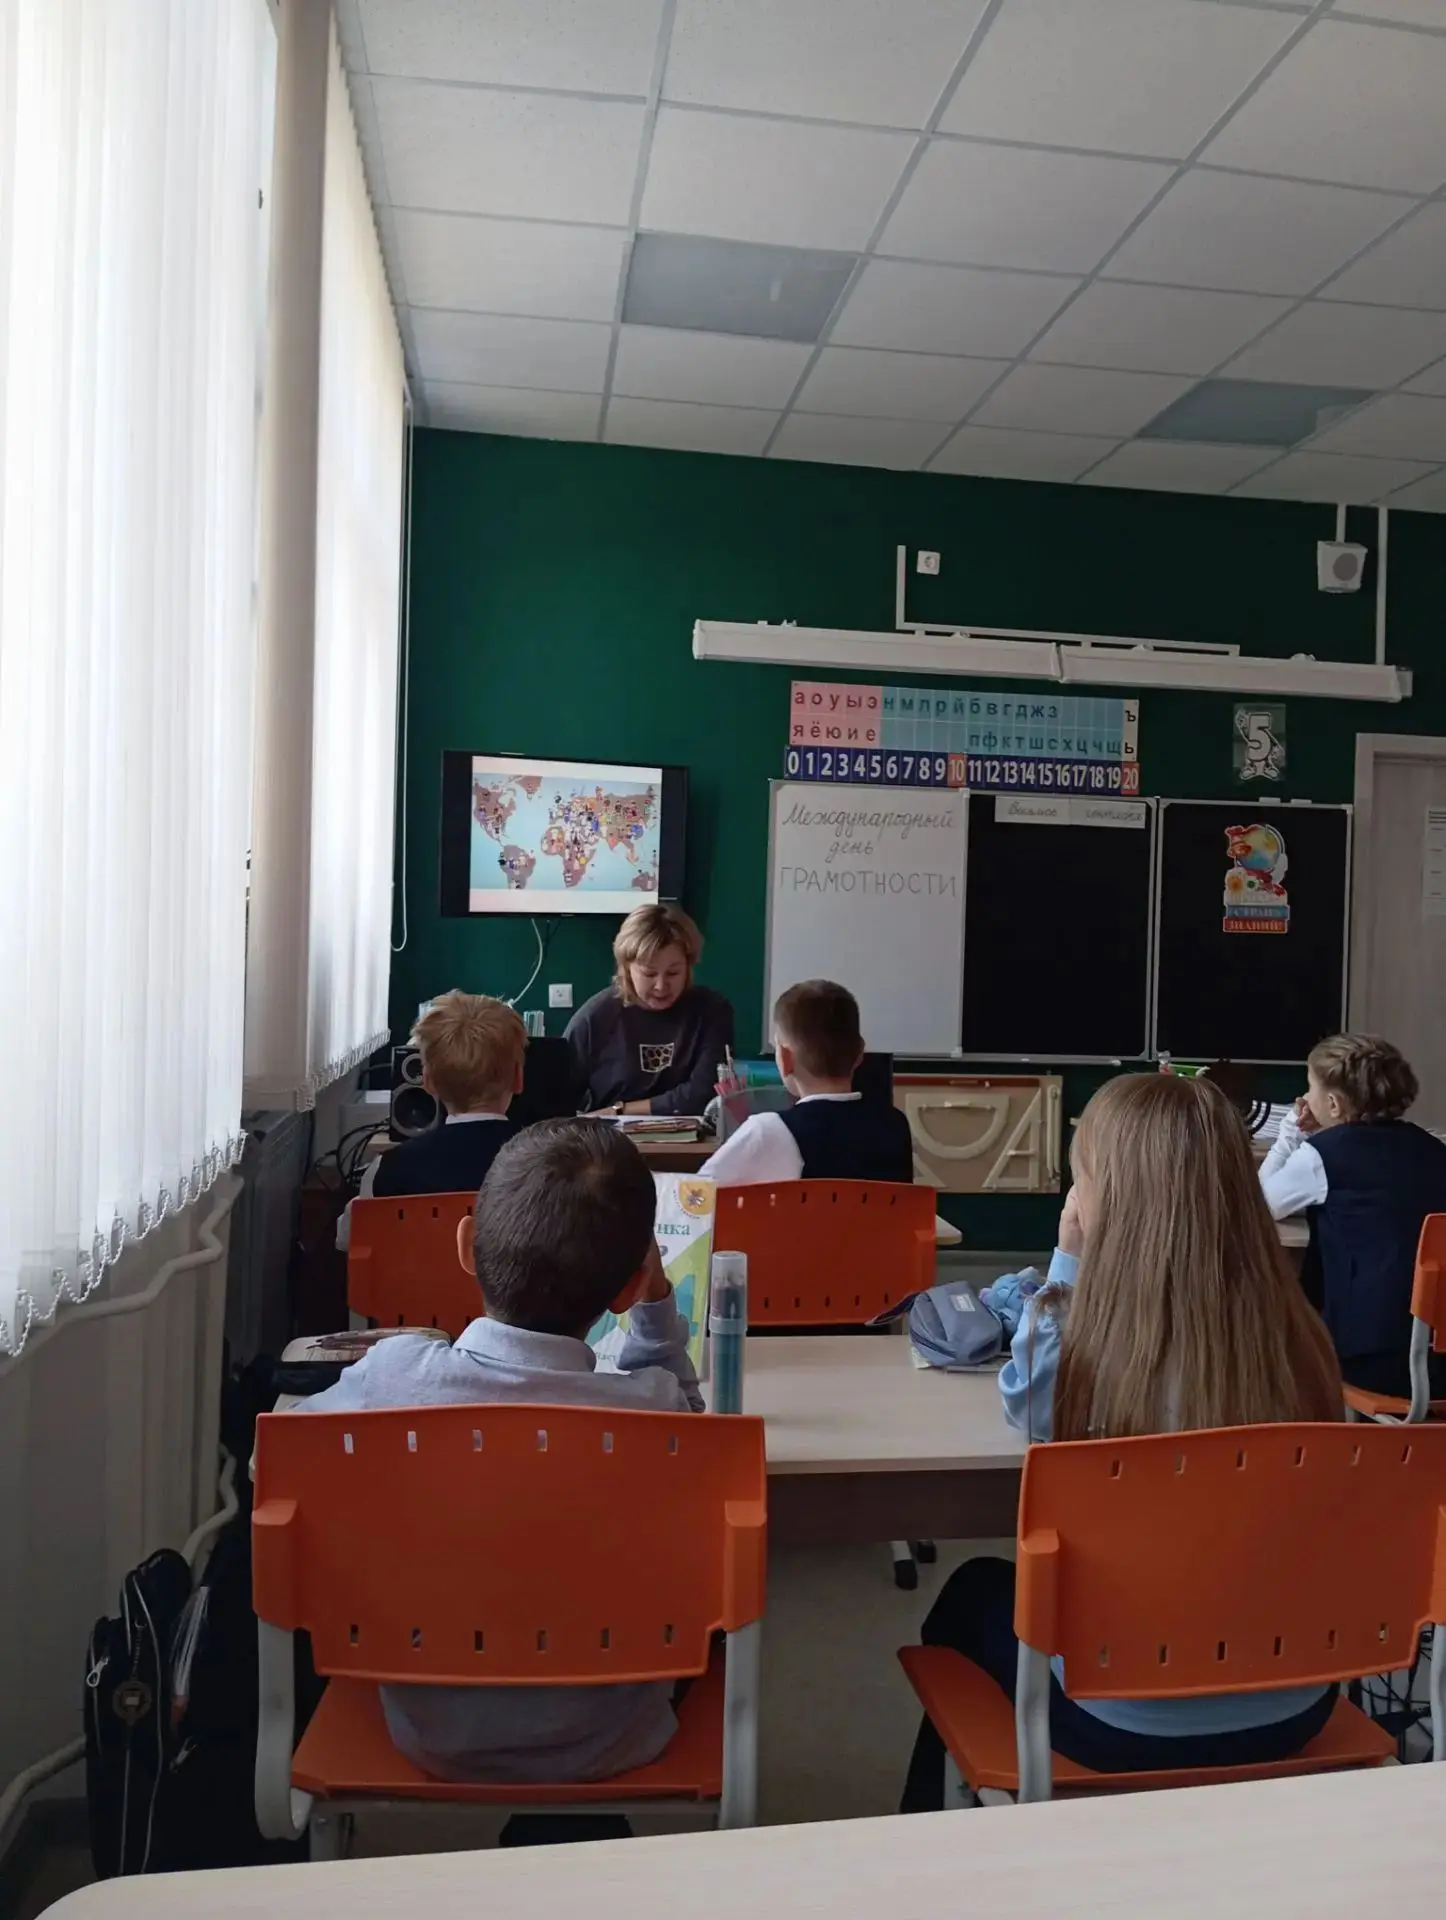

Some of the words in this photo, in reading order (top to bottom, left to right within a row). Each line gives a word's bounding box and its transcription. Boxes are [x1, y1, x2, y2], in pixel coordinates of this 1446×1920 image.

[788, 752, 799, 774] 0
[806, 752, 813, 774] 1
[821, 753, 832, 775] 2
[838, 754, 849, 776] 3
[854, 755, 865, 777] 4
[870, 756, 881, 777] 5
[886, 756, 897, 778] 6
[903, 757, 914, 778] 7
[919, 758, 930, 780] 8
[935, 759, 945, 780] 9
[951, 759, 964, 781] 10
[968, 760, 981, 781] 11
[985, 761, 1000, 782] 12
[1004, 761, 1017, 783] 13
[1020, 762, 1036, 784] 14
[1038, 763, 1052, 785] 15
[1055, 764, 1070, 786] 16
[1072, 765, 1087, 786] 17
[1090, 766, 1104, 787] 18
[1107, 767, 1121, 788] 19
[1123, 768, 1138, 789] 20
[782, 803, 953, 841] Международный
[825, 841, 874, 863] день
[780, 866, 956, 897] ГРАМОТНОСТИ
